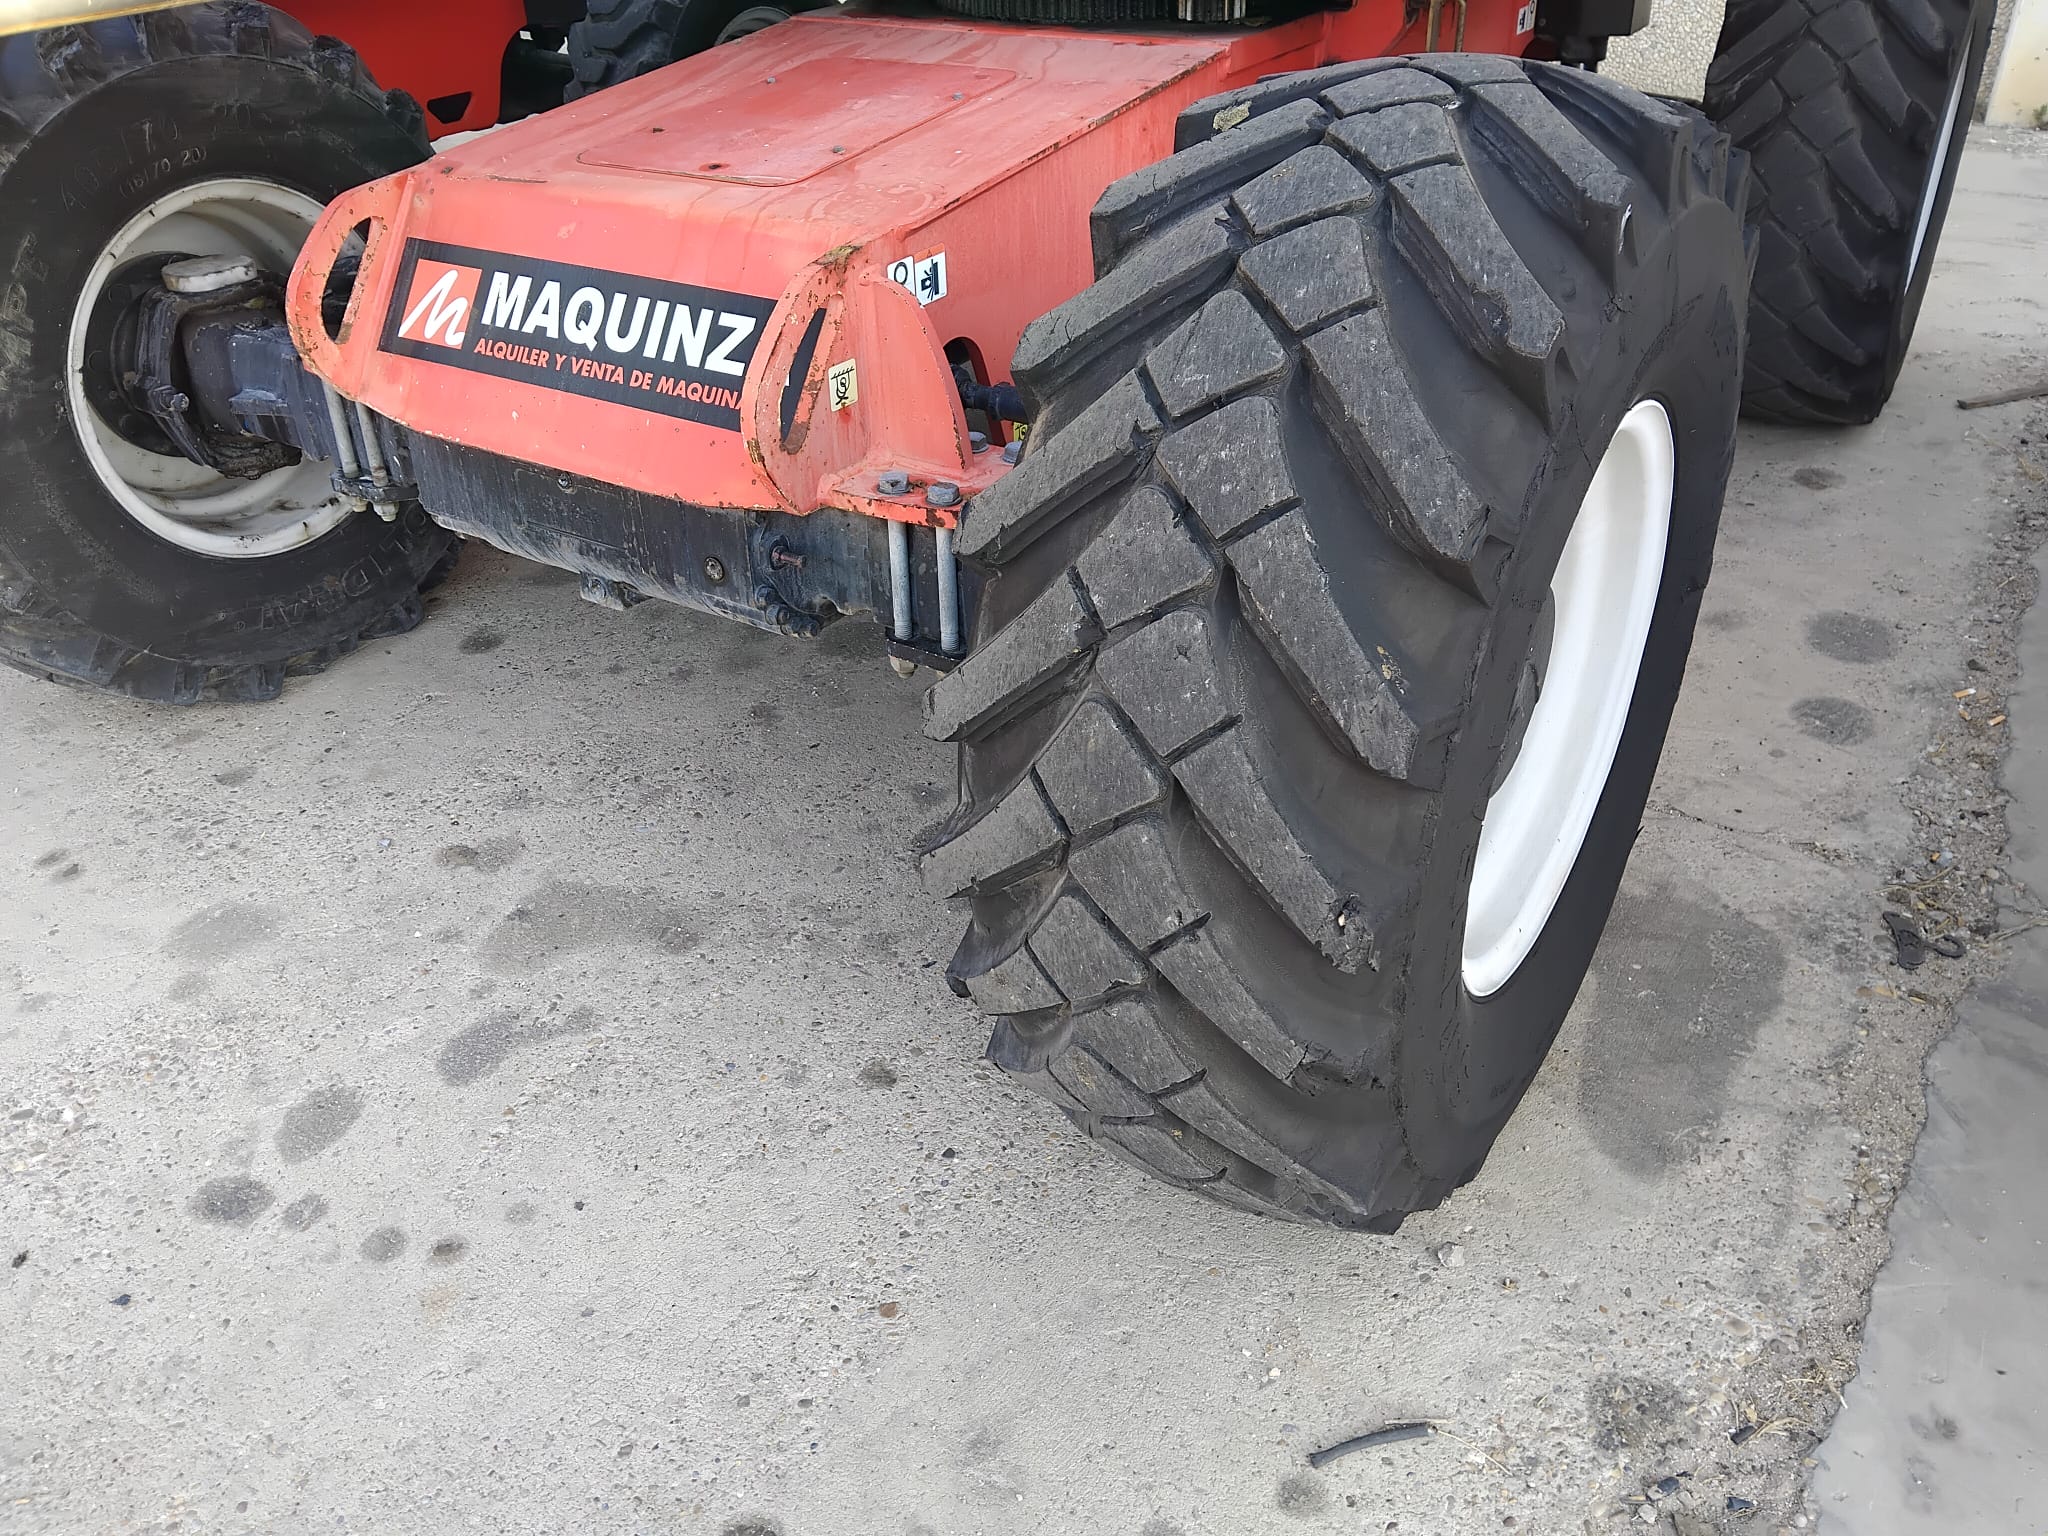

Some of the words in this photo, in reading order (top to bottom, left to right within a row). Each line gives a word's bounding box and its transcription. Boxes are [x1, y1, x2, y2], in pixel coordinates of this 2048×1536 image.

[480, 270, 757, 377] MAQUINZ
[473, 337, 549, 369] ALQUILER
[555, 354, 567, 372] Y
[570, 357, 624, 386] VENTA
[629, 370, 653, 390] DE
[656, 376, 741, 411] MAQUIN
